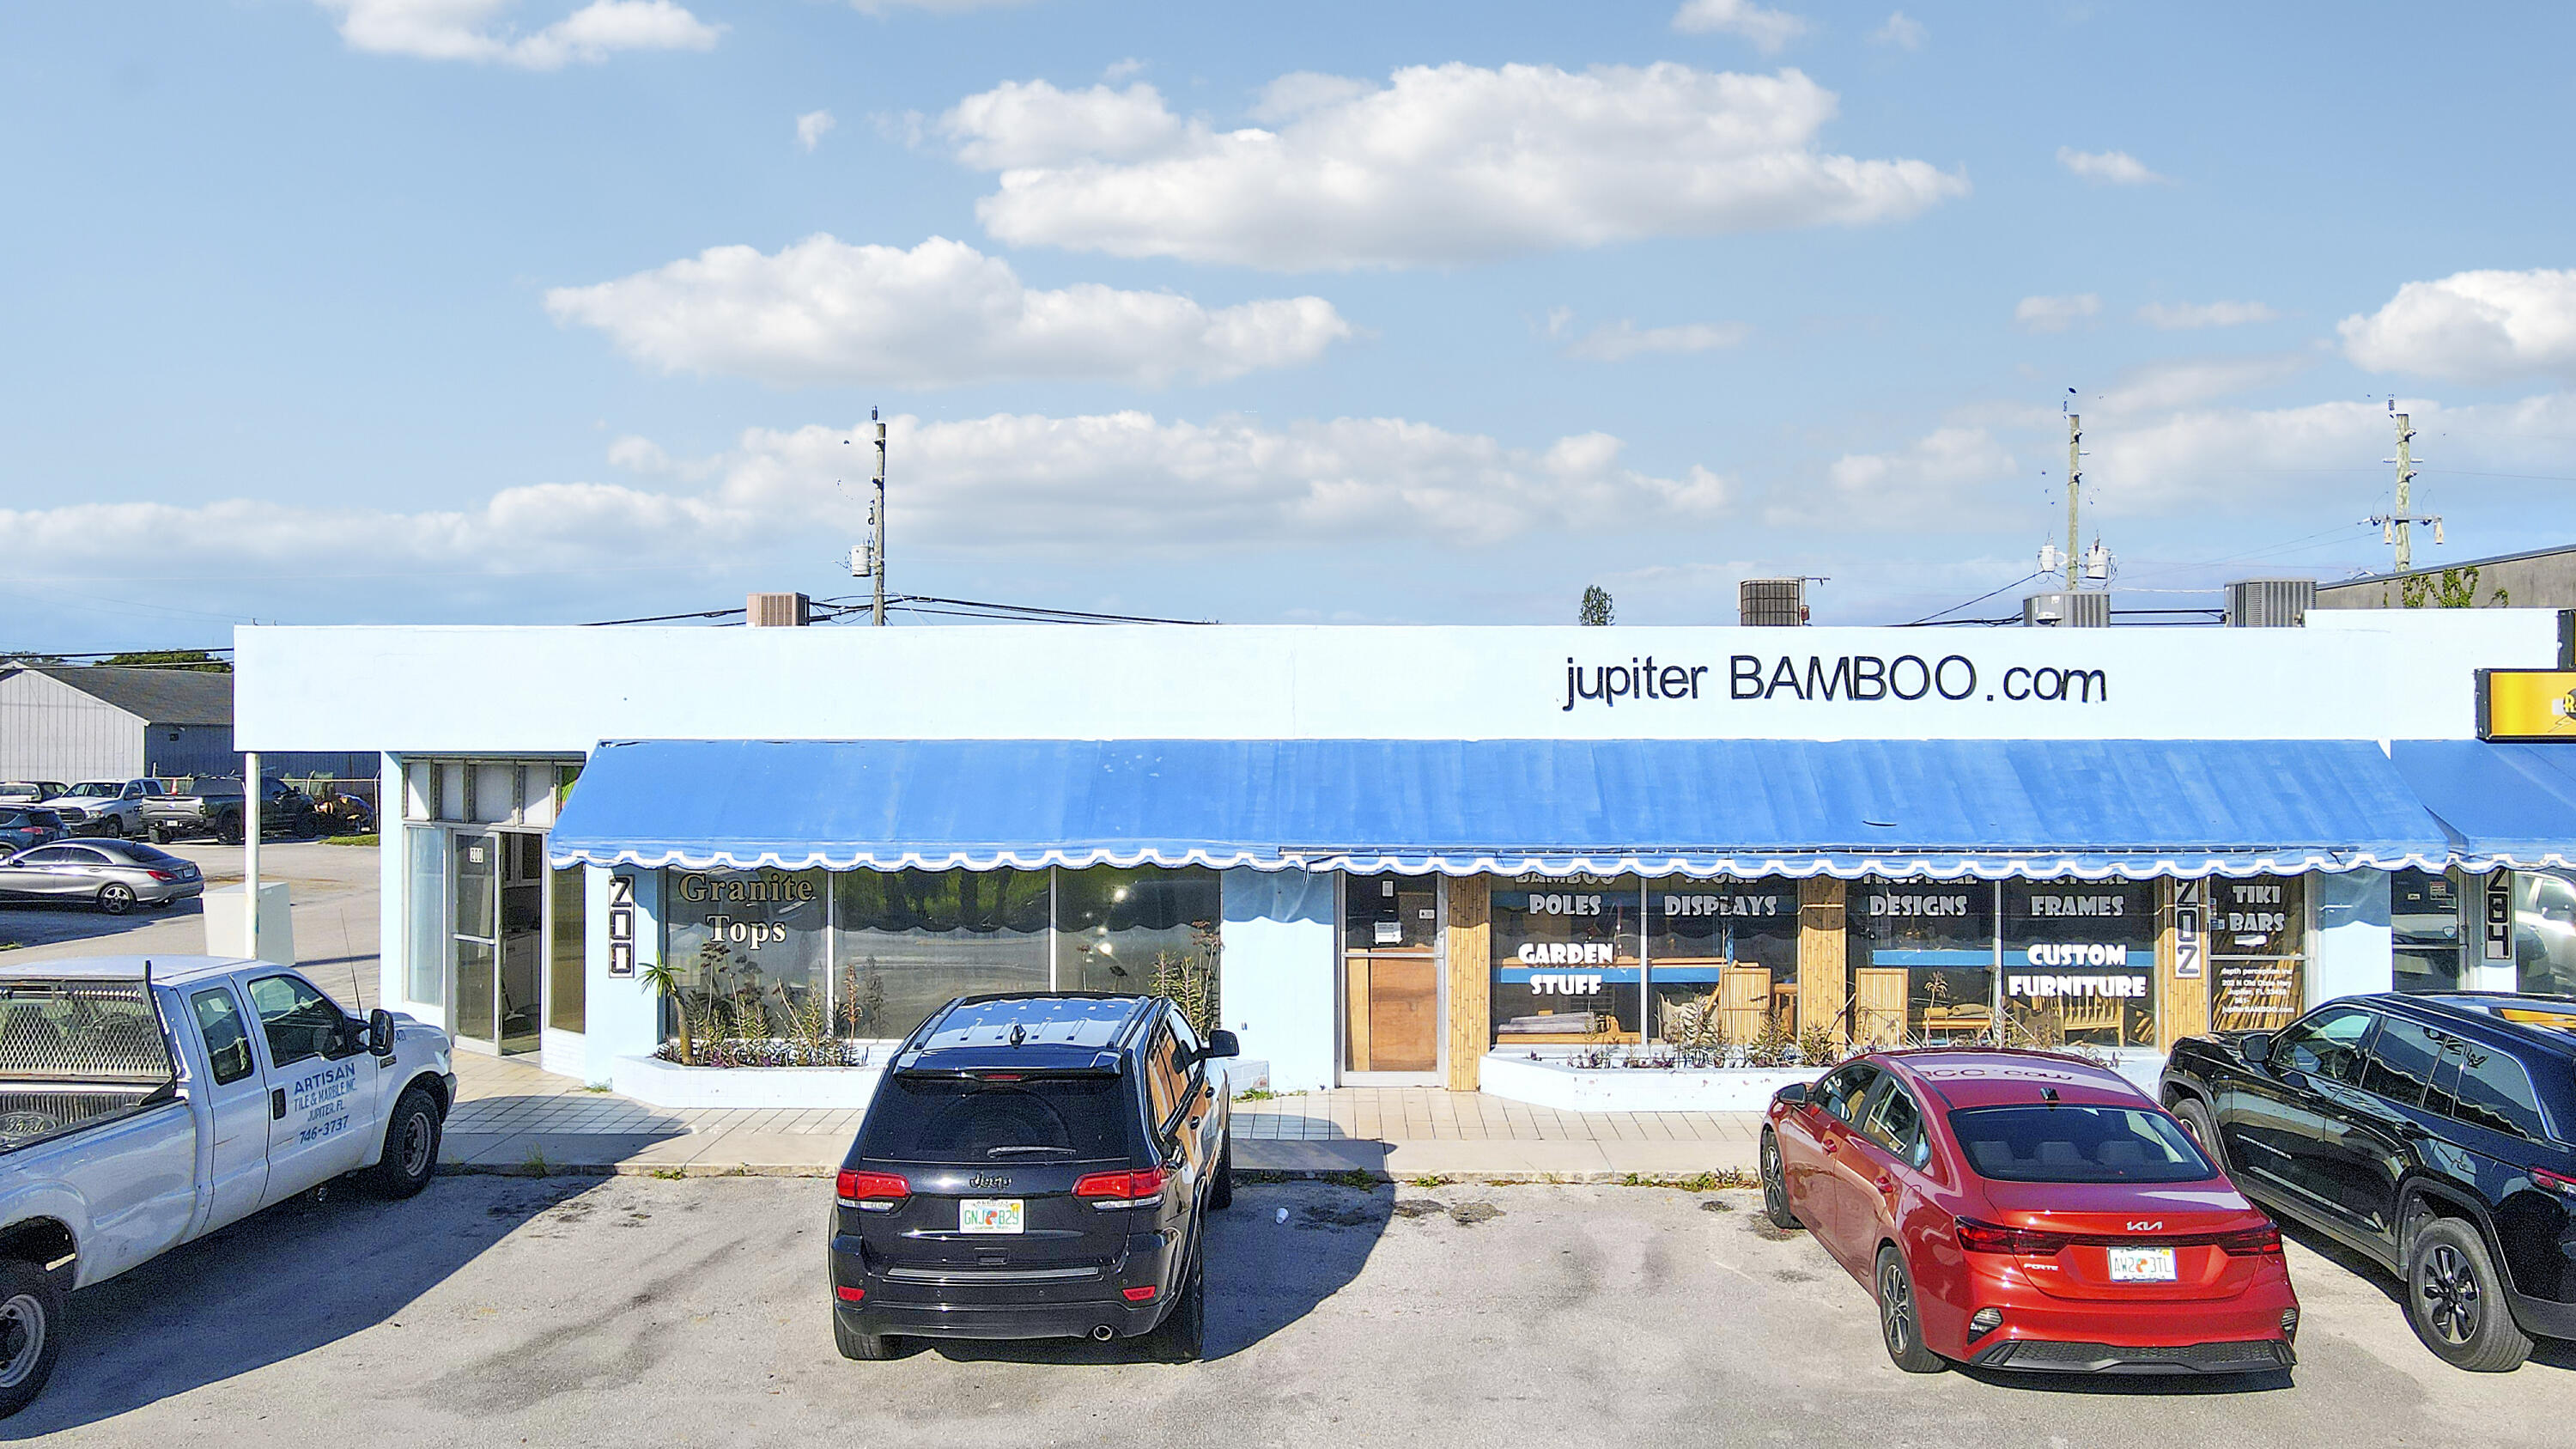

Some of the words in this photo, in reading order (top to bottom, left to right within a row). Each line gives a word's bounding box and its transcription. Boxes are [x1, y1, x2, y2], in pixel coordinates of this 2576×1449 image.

[1562, 655, 1709, 712] jupiter
[678, 873, 814, 903] Granite
[2233, 886, 2281, 904] TIKI
[1529, 893, 1602, 916] POLES
[1664, 895, 1777, 916] DISPLAYS
[1869, 895, 1968, 916] DESIGNS
[2031, 895, 2124, 916] FRAMES
[610, 877, 632, 974] 200
[706, 914, 787, 950] Tops
[2176, 879, 2199, 974] 202
[2228, 912, 2285, 932] BARS
[1517, 942, 1614, 965] GARDEN
[2026, 943, 2127, 966] CUSTOM
[2221, 967, 2242, 976] depth
[1529, 974, 1602, 995] STUFF
[2008, 975, 2147, 998] FURNITURE
[294, 1062, 356, 1096] ARTISAN
[295, 1095, 310, 1112] TILE
[310, 1092, 318, 1106] &
[319, 1081, 345, 1103] MARBLE
[5, 1116, 45, 1133] Ford
[299, 1115, 349, 1145] 746-3737
[969, 1172, 1012, 1191] Jeep
[2126, 1221, 2163, 1231] KIA
[2023, 1263, 2059, 1271] FORTE
